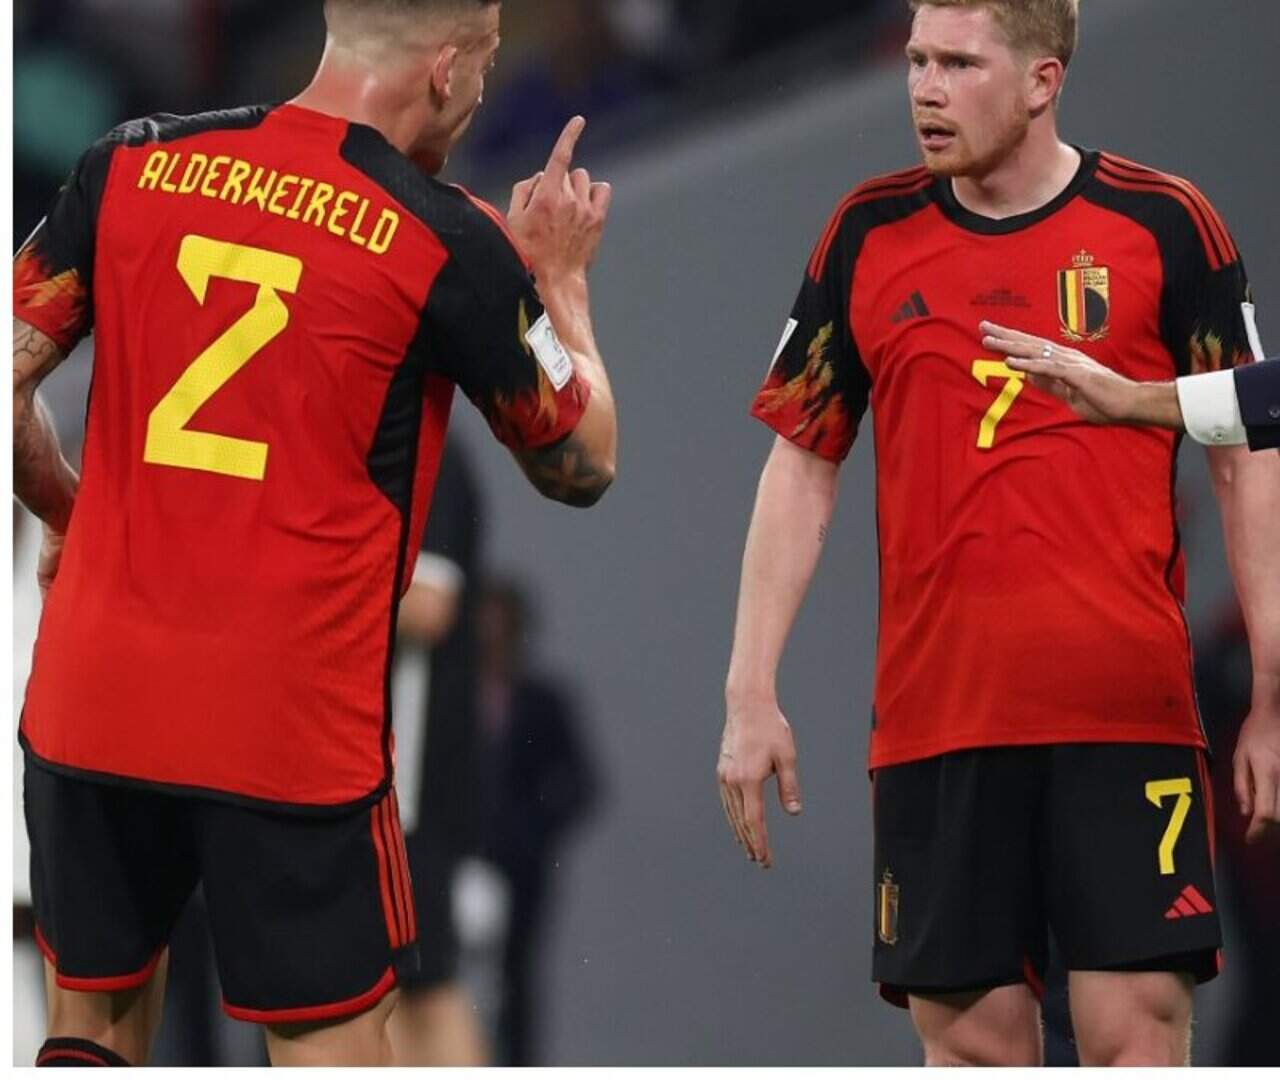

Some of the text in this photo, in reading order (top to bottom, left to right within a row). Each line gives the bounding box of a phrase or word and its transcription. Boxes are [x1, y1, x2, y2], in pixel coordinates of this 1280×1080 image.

[138, 150, 400, 255] ALDERWEIRELD
[143, 234, 303, 481] 2
[971, 358, 1026, 449] 7
[1145, 777, 1192, 875] 7
